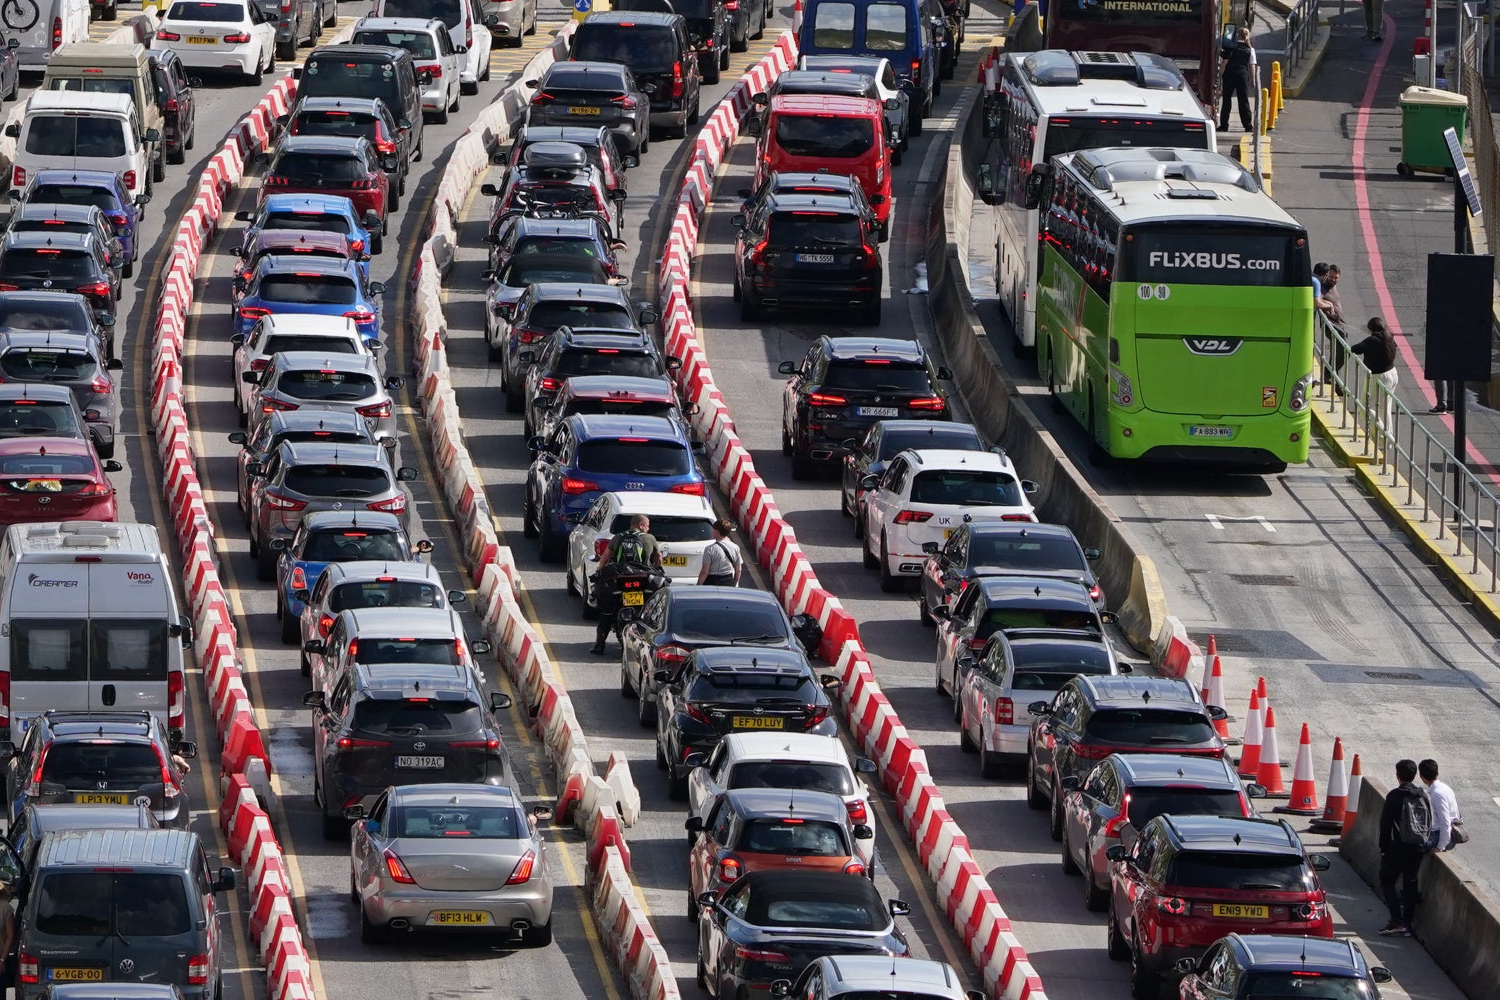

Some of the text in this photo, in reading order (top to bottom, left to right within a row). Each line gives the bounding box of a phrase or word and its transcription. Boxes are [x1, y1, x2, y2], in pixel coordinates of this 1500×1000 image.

[1104, 0, 1193, 13] INTERNATIONAL
[1148, 249, 1280, 271] FLiXBUS.com
[1140, 285, 1151, 298] 100
[1193, 339, 1232, 351] VDL
[861, 407, 898, 417] WR 666FC
[1194, 427, 1228, 435] FA-693-WR
[938, 517, 951, 525] UK
[671, 555, 686, 565] MLU
[127, 571, 151, 580] Vano
[32, 578, 78, 588] DREAMER
[739, 717, 782, 729] EF70 LUY
[414, 756, 443, 767] 319AC
[81, 793, 122, 804] LP13 YMU
[135, 798, 149, 808] UK
[1219, 906, 1263, 917] EN19 YWD
[440, 913, 483, 923] BF13 HLW
[55, 969, 101, 980] 6-VGB-00
